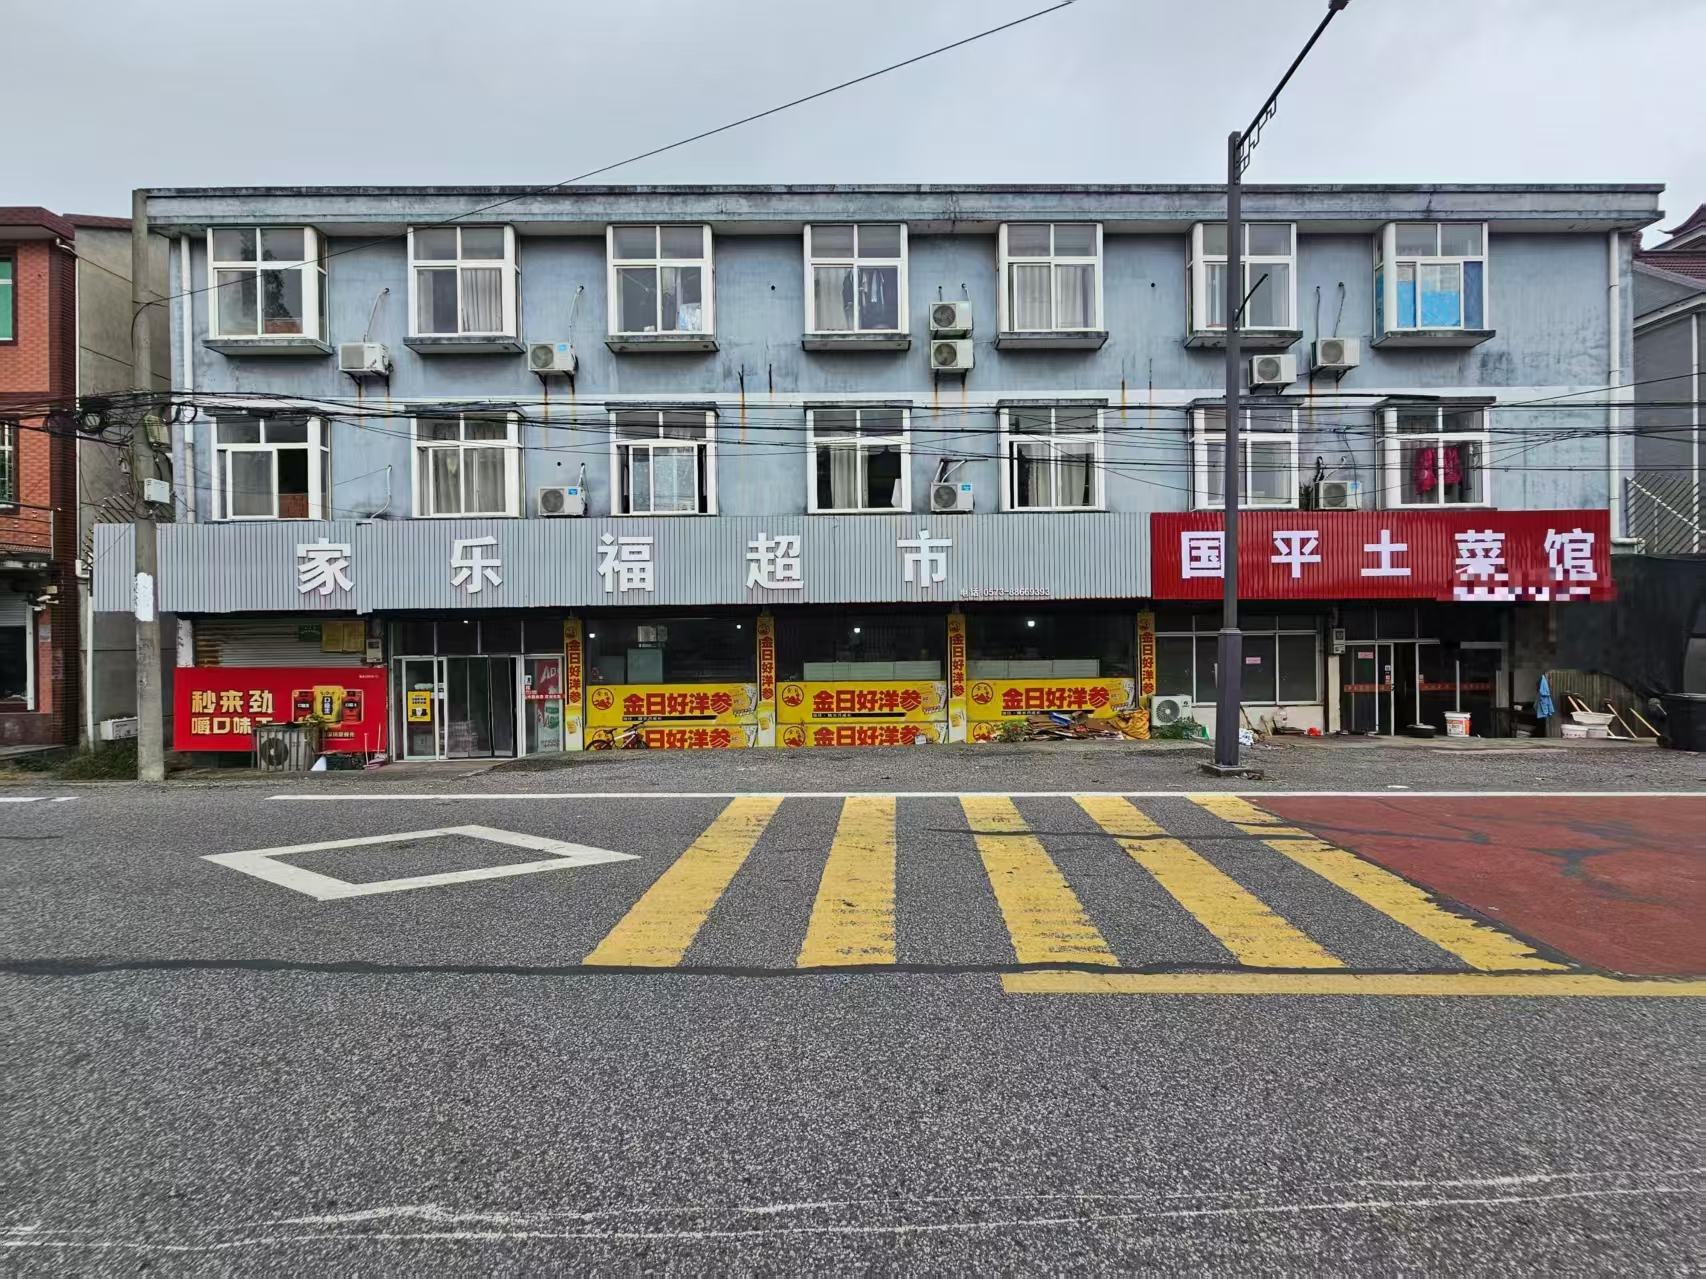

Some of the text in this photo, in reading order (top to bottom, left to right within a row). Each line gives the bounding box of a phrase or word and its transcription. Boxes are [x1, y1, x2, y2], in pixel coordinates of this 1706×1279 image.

[297, 531, 953, 595] 家乐福超市
[1181, 528, 1597, 581] 国平土菜馆
[960, 587, 979, 597] 电话
[568, 639, 581, 704] 金日好洋参
[761, 636, 774, 700] 金日好洋参
[952, 634, 965, 697] 金日好洋参
[1142, 632, 1154, 695] 金日好洋参
[191, 690, 274, 714] 秒来劲
[623, 692, 733, 715] 金日好洋参
[813, 690, 922, 712] 金日好洋参
[1002, 687, 1110, 710] 金日好洋参
[814, 725, 921, 747] 金日好洋参
